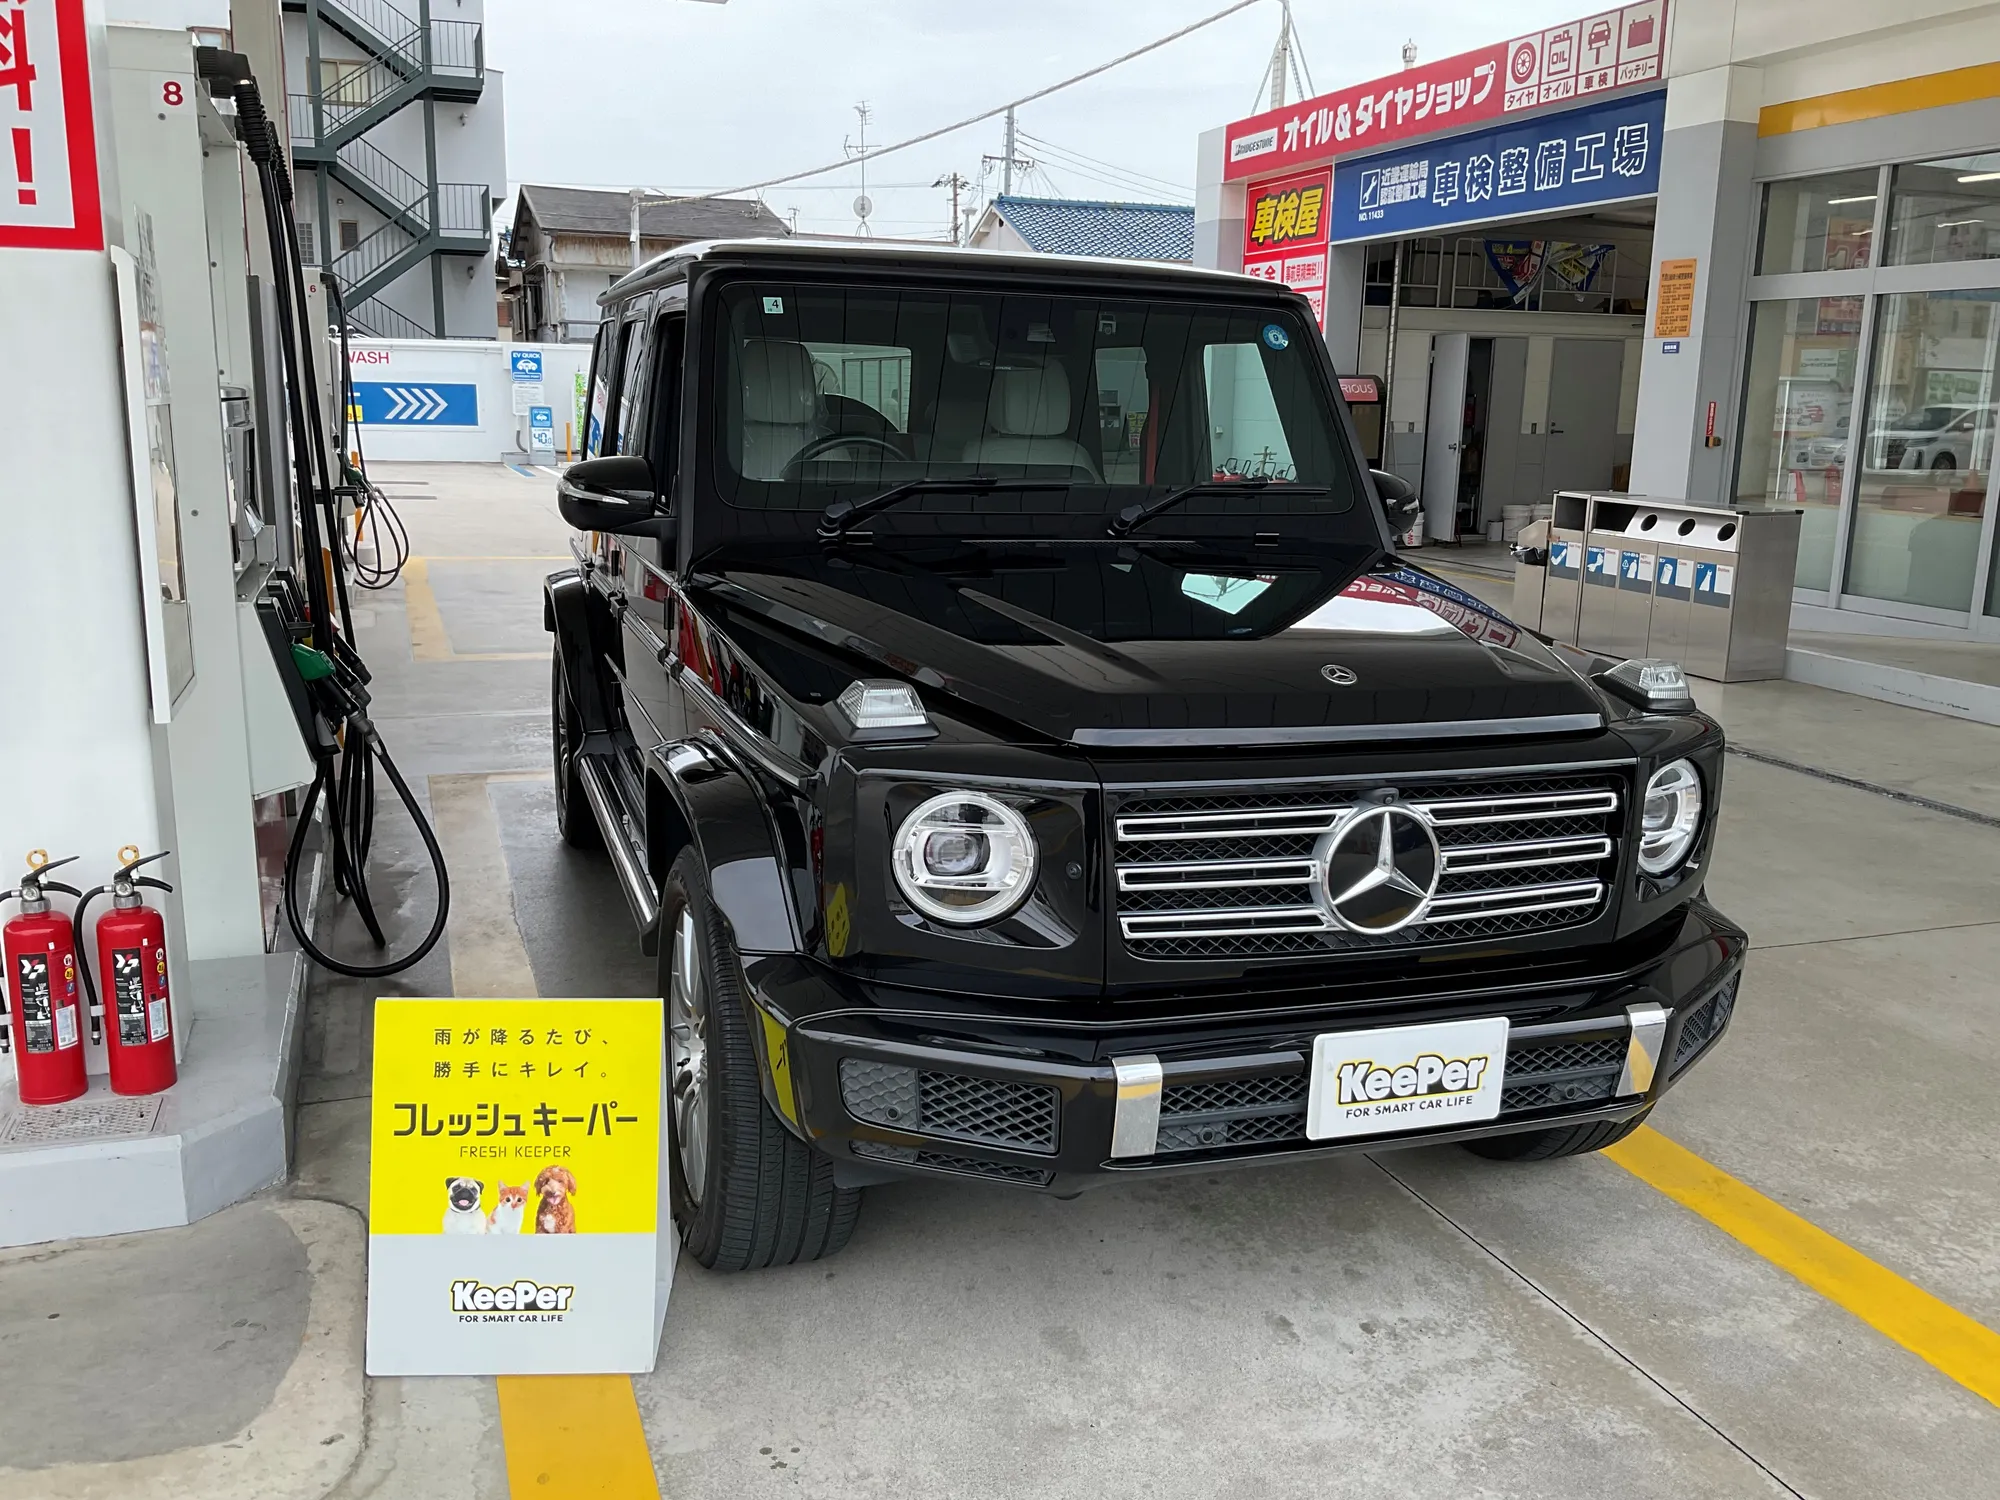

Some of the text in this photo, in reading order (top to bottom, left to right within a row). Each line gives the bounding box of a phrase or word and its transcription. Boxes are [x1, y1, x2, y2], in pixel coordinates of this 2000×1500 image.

[1551, 52, 1567, 65] OIL
[1620, 62, 1655, 80] バッテリー
[1543, 81, 1571, 99] オイル
[1584, 72, 1608, 90] 車検
[163, 81, 183, 106] 8
[1507, 90, 1534, 108] タイヤ
[1283, 60, 1497, 152] オイル&タイヤショップ
[1234, 136, 1274, 156] BRIDGESTONE
[1432, 122, 1649, 207] 車検整備工場
[1251, 187, 1323, 244] 車検屋
[1358, 209, 1384, 222] NO. 11433
[310, 284, 317, 293] 6
[772, 299, 779, 308] 4
[434, 1028, 608, 1046] 雨が降るたび、
[433, 1061, 607, 1078] 勝手にキレイ。
[1337, 1054, 1488, 1106] KeePer
[1345, 1095, 1473, 1119] FOR SMART CAR LIFE
[393, 1100, 639, 1138] フレッシュキーパー
[460, 1146, 571, 1157] FRESH KEEPER
[450, 1279, 575, 1312] KeePer
[459, 1314, 564, 1323] FOR SMART CAR LIFE
